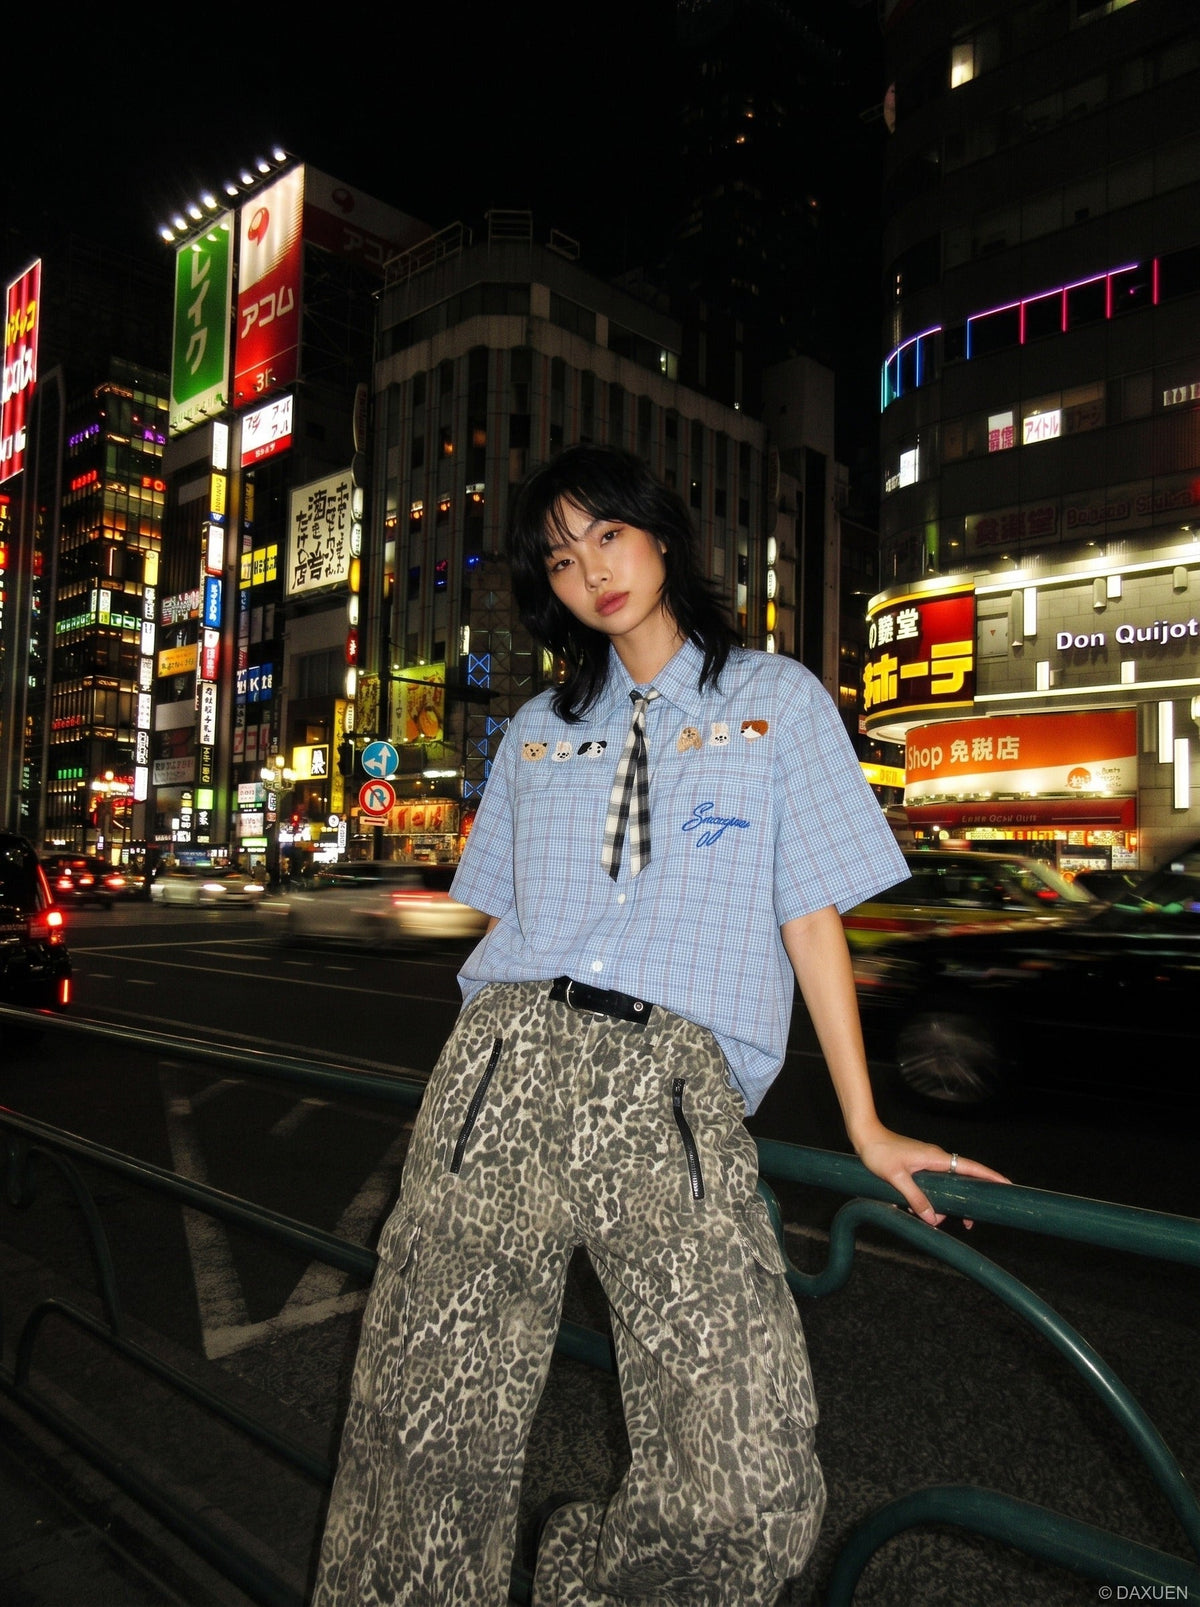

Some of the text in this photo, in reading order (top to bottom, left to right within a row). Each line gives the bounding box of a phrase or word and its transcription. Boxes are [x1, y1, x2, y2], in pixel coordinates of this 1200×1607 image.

[185, 252, 212, 376] レイク
[240, 285, 295, 339] アコム
[1056, 631, 1105, 650] Don
[908, 736, 1020, 771] Shop 免税店
